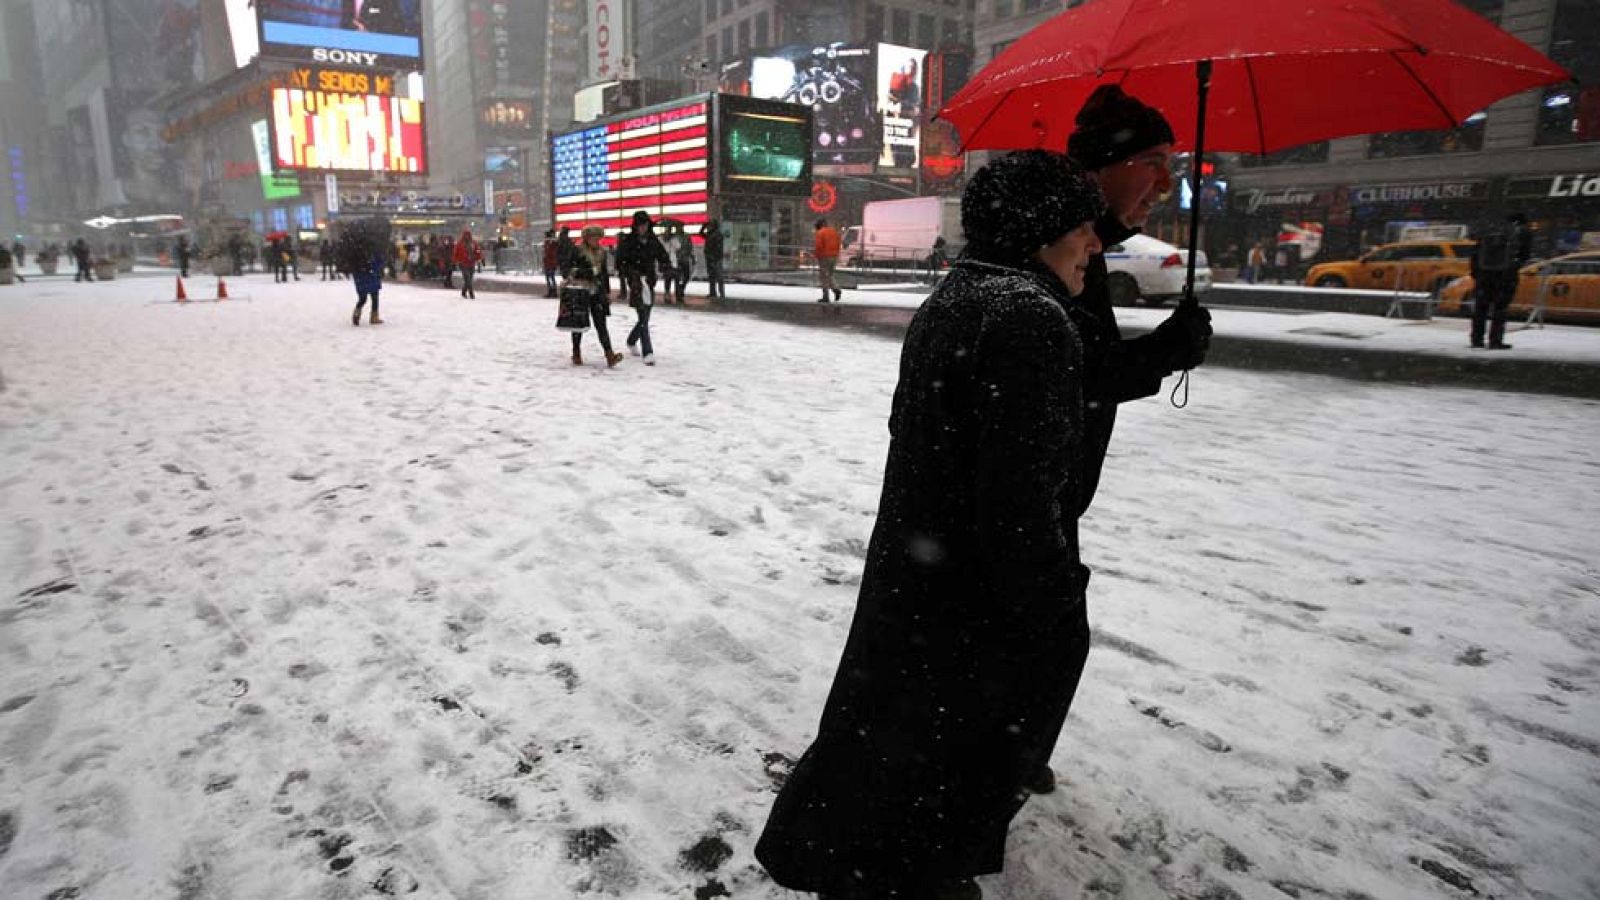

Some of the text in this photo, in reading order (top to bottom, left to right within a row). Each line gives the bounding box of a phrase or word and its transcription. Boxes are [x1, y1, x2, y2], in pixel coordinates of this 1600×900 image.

[312, 48, 378, 65] SONY
[318, 69, 369, 93] SENDS
[1358, 183, 1472, 202] CLUBHOUSE
